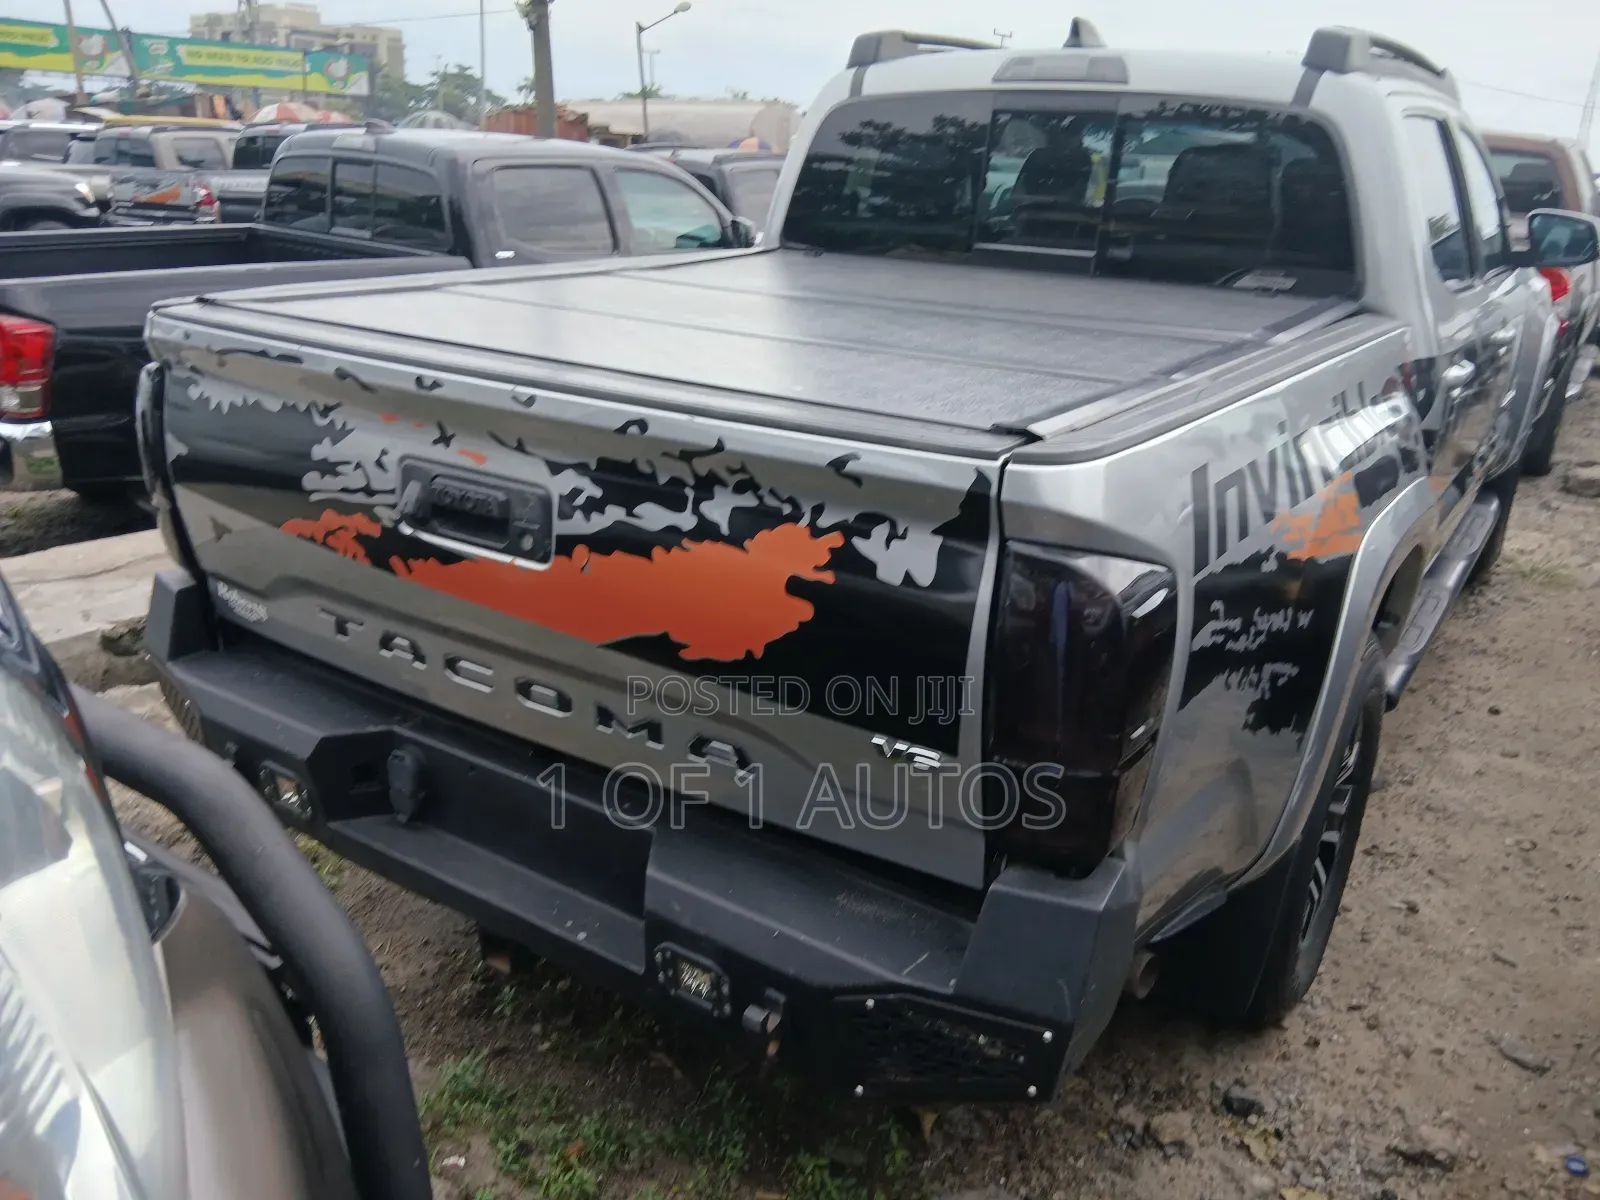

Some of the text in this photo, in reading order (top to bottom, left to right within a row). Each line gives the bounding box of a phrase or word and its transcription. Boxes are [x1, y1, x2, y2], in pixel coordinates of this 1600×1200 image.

[1191, 379, 1406, 577] Invinibl
[317, 604, 756, 779] TACOMA
[871, 734, 941, 771] V6
